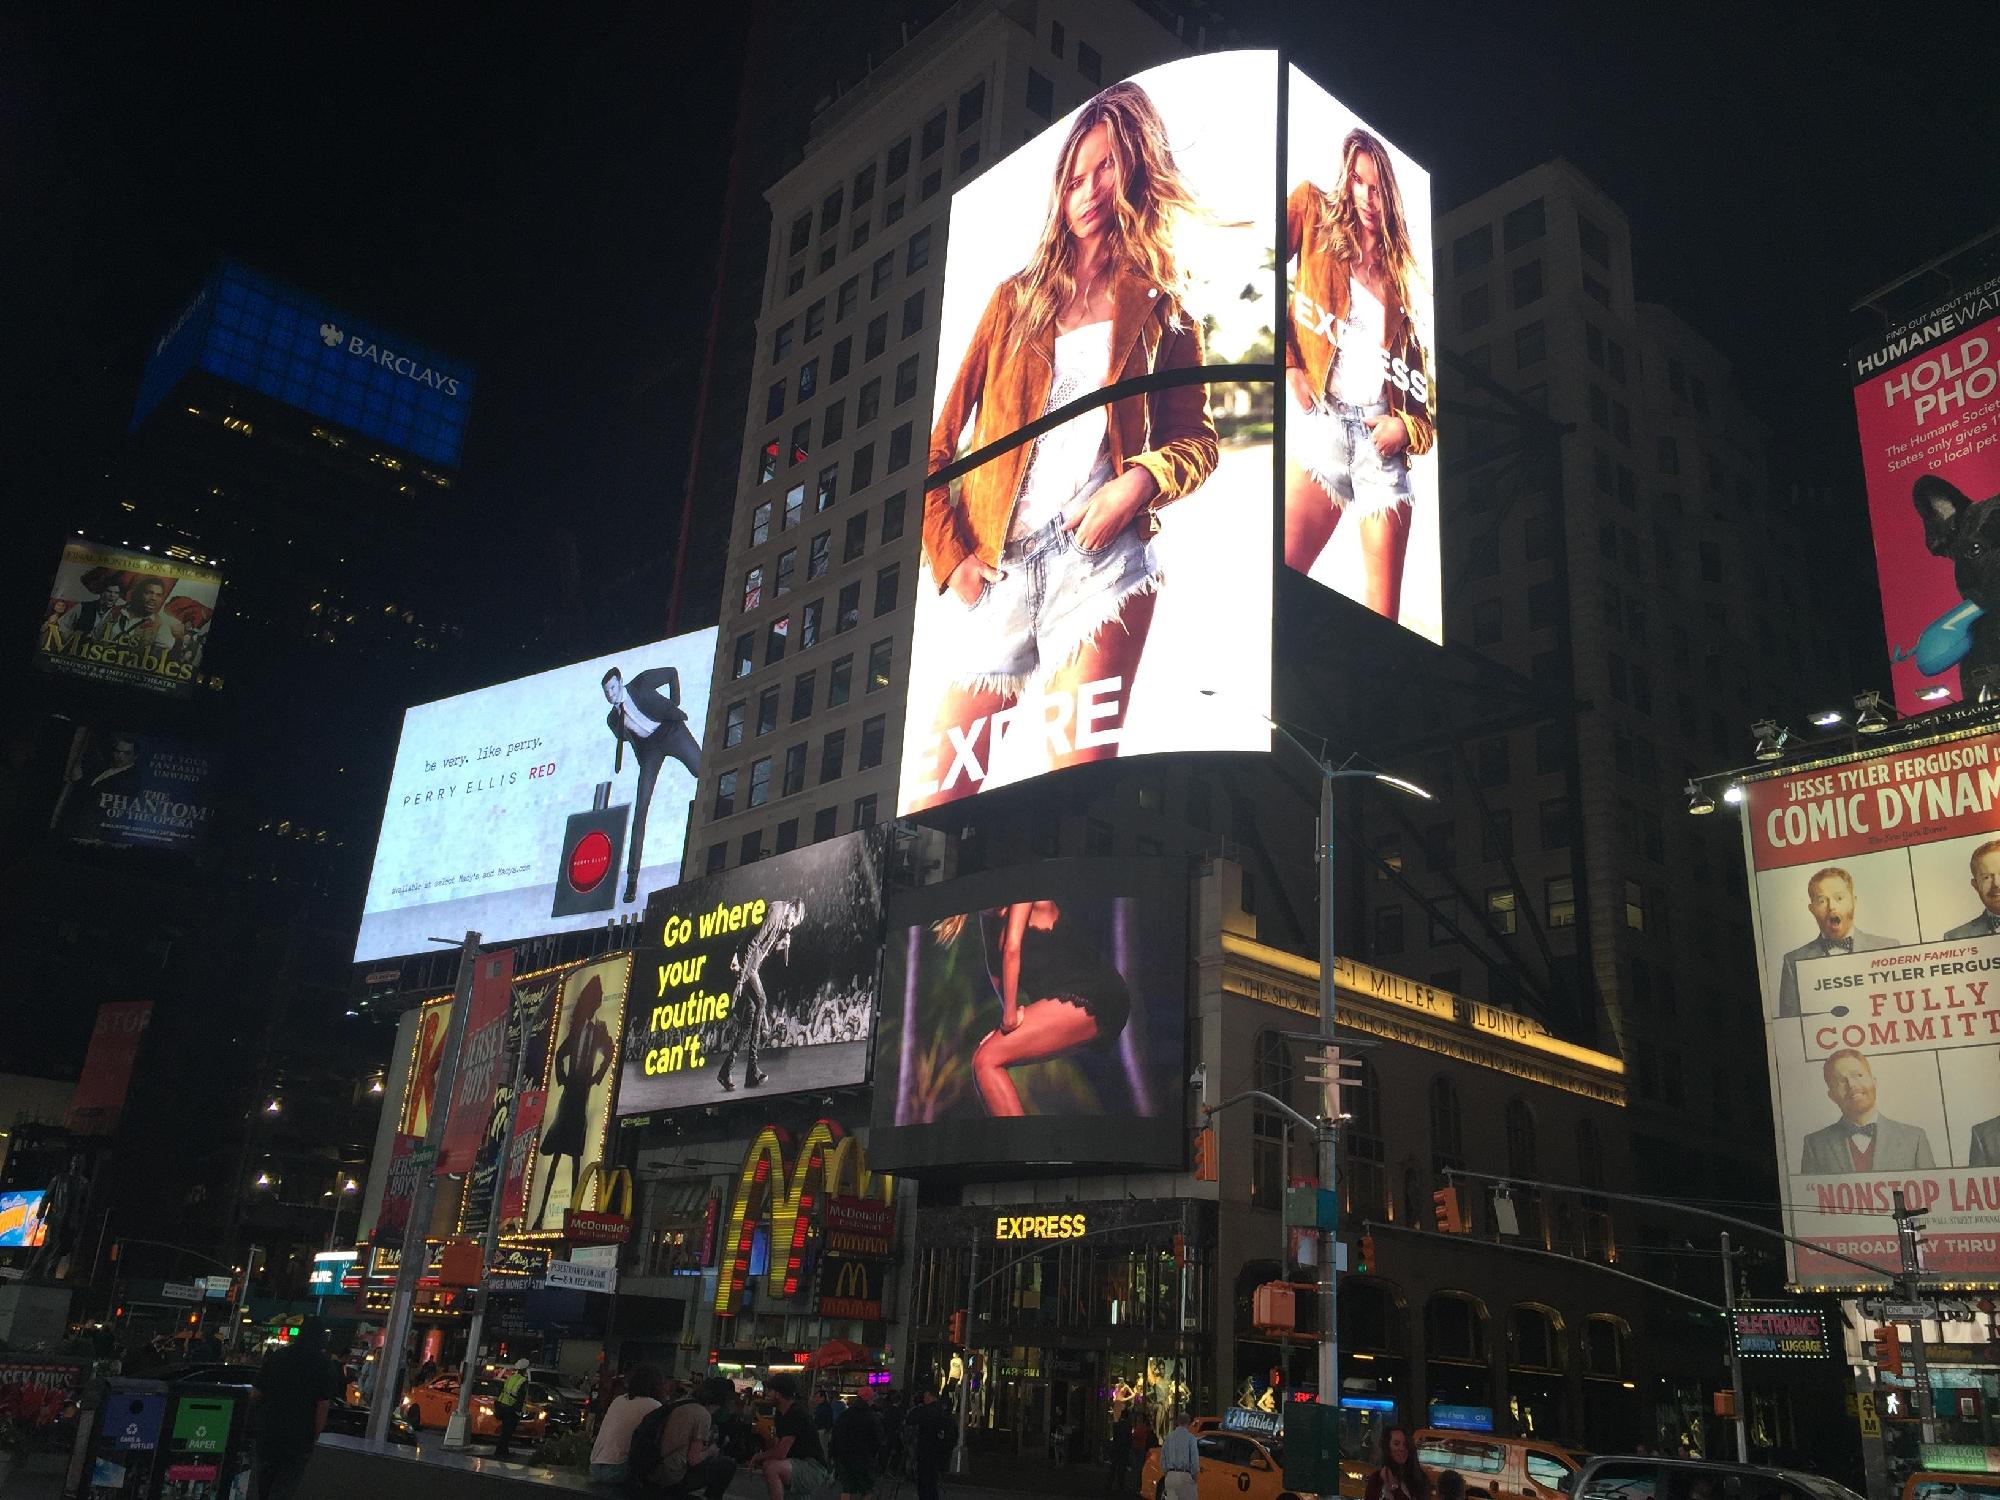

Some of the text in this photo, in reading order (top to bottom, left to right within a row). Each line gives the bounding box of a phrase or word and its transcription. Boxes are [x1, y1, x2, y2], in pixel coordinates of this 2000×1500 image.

[1886, 326, 1907, 342] FIND
[1909, 314, 1927, 329] OUT
[1930, 297, 1962, 319] ABOUT
[1964, 286, 1982, 301] THE
[348, 335, 460, 396] BARCLAYS
[1884, 337, 1989, 408] HOLD
[1885, 442, 1908, 457] The
[1910, 419, 1959, 447] Humane
[1888, 451, 1924, 472] States
[1927, 438, 1953, 455] only
[1955, 423, 1988, 445] gives
[1928, 433, 1998, 470] to local pet
[42, 624, 194, 681] Misérables
[101, 622, 140, 648] Les
[425, 737, 543, 773] be very. like perry.
[1838, 763, 1891, 792] TYLER
[1894, 743, 1990, 782] FERGUSON
[154, 769, 200, 782] UNWIND
[403, 762, 556, 807] PERRY ELLIS RED
[99, 792, 207, 821] PHANTOM
[143, 789, 170, 801] THE
[106, 808, 124, 818] OF
[152, 815, 193, 829] OPERA
[1766, 793, 1870, 849] COMIC
[1886, 832, 1900, 843] New
[1901, 828, 1920, 841] York
[663, 899, 767, 948] Go where
[1871, 946, 1979, 969] MODERN FAMILY'S
[658, 954, 708, 998] your
[1370, 971, 1437, 1010] MILLER
[1814, 974, 1864, 992] JESSE
[1869, 967, 1925, 985] TYLER
[650, 989, 730, 1033] routine
[1244, 978, 1268, 1000] THE
[1271, 987, 1308, 1011] SHOW
[1358, 1014, 1389, 1035] SHOE
[1869, 981, 1989, 1018] FULLY
[463, 1017, 507, 1071] JERSEY
[645, 1033, 706, 1076] can't.
[459, 1062, 495, 1107] BOYS
[571, 1218, 631, 1234] McDonald's
[829, 1204, 889, 1223] McDonald's
[995, 1214, 1086, 1240] EXPRESS
[1930, 1216, 1948, 1226] WALL
[1949, 1216, 1973, 1226] STREET
[1944, 1238, 1997, 1253] THRU
[1737, 1314, 1820, 1335] ELECTRONICS
[1888, 1305, 1929, 1314] ONE WAY
[1781, 1339, 1823, 1353] LUGGAGE
[1239, 1413, 1274, 1431] Matilda
[1862, 1395, 1877, 1431] ATM
[188, 1440, 216, 1450] PAPER
